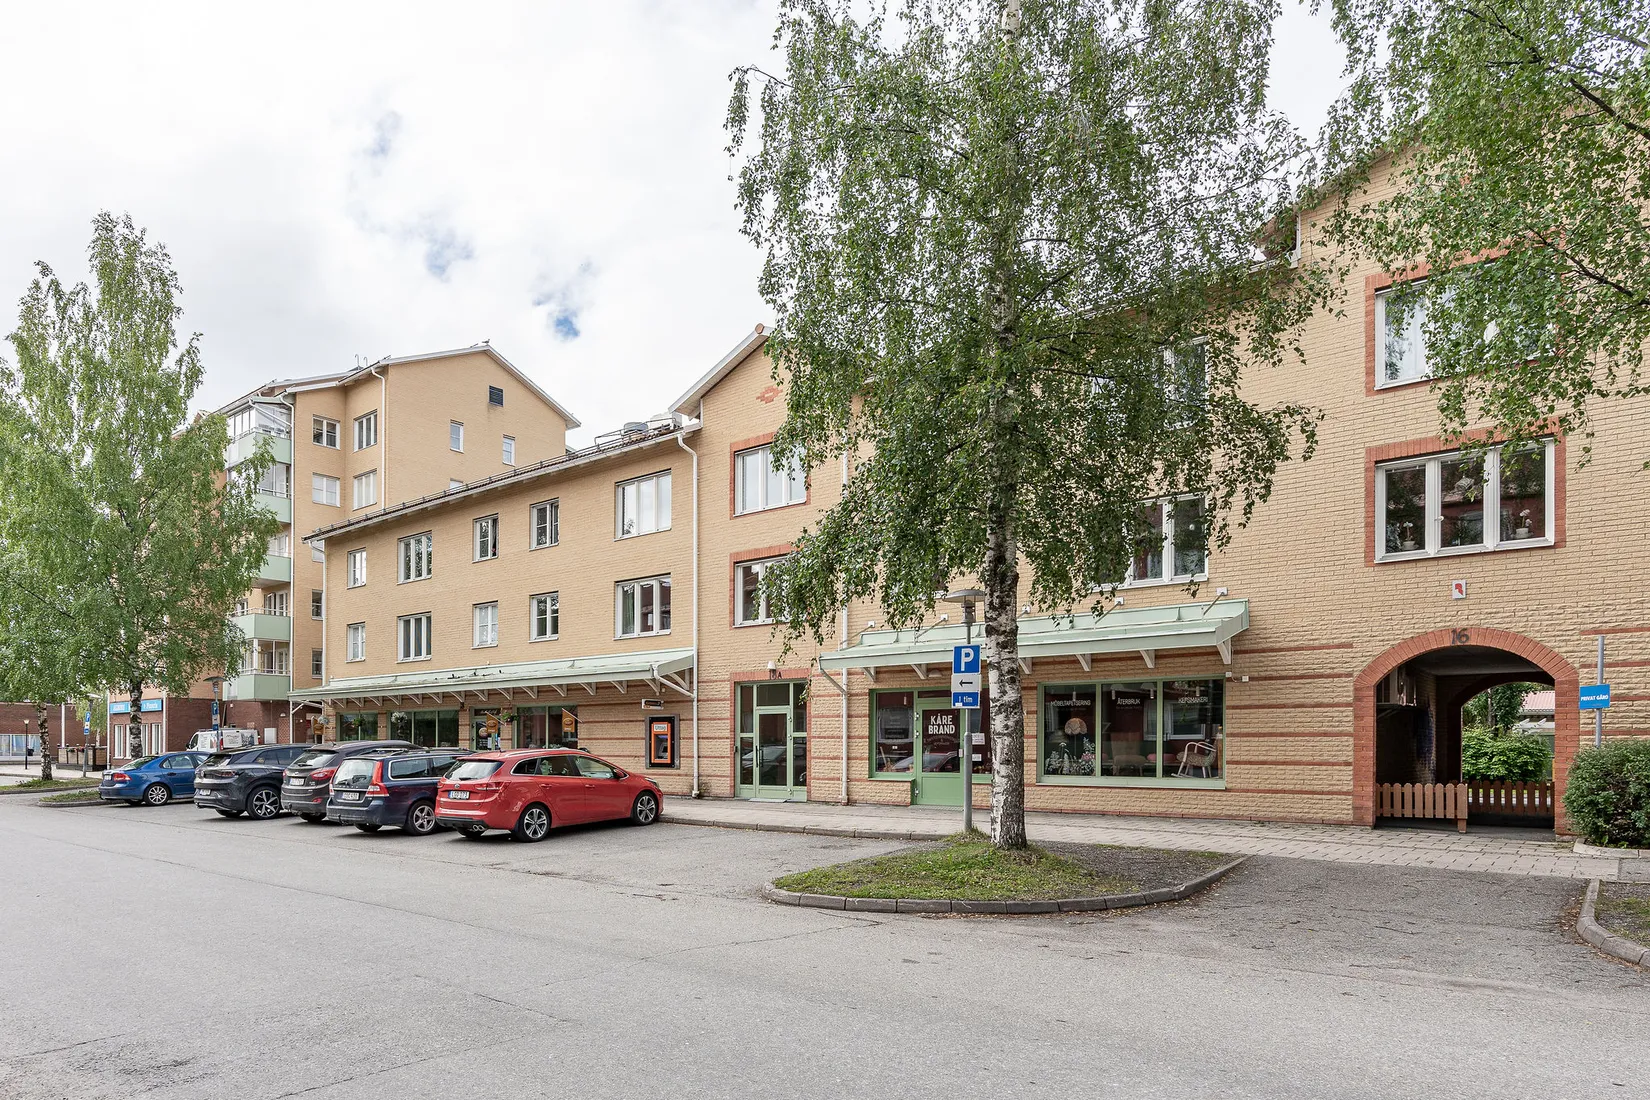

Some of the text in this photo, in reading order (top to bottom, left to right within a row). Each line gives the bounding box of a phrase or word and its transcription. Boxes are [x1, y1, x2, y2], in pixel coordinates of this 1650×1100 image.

[1451, 628, 1469, 645] 16
[960, 648, 974, 672] P
[963, 695, 973, 703] tim
[930, 713, 953, 725] KÅRE
[928, 725, 956, 735] BRAND
